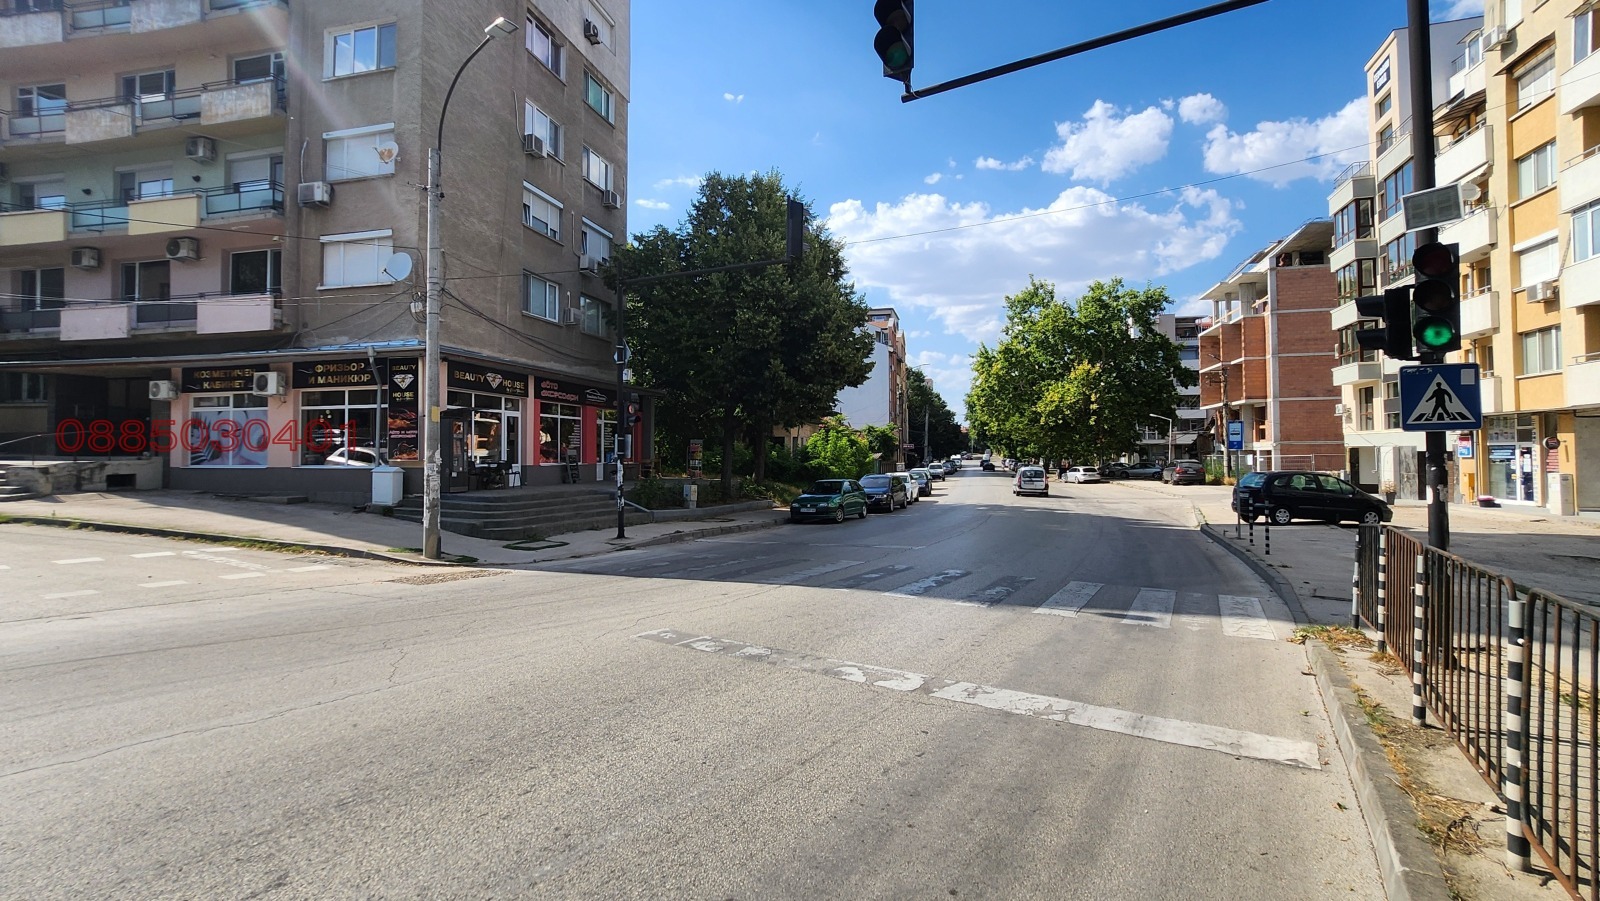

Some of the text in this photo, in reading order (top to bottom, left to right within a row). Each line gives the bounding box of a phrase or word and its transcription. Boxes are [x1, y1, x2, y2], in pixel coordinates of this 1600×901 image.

[314, 362, 365, 373] ФРИЗЬОР
[194, 368, 256, 379] КОЗМЕТИЧЕН
[308, 373, 371, 384] И МАНИКЮР
[203, 380, 246, 389] КАБИНЕТ
[454, 370, 486, 383] BEAUTY
[502, 379, 525, 390] HOUSE
